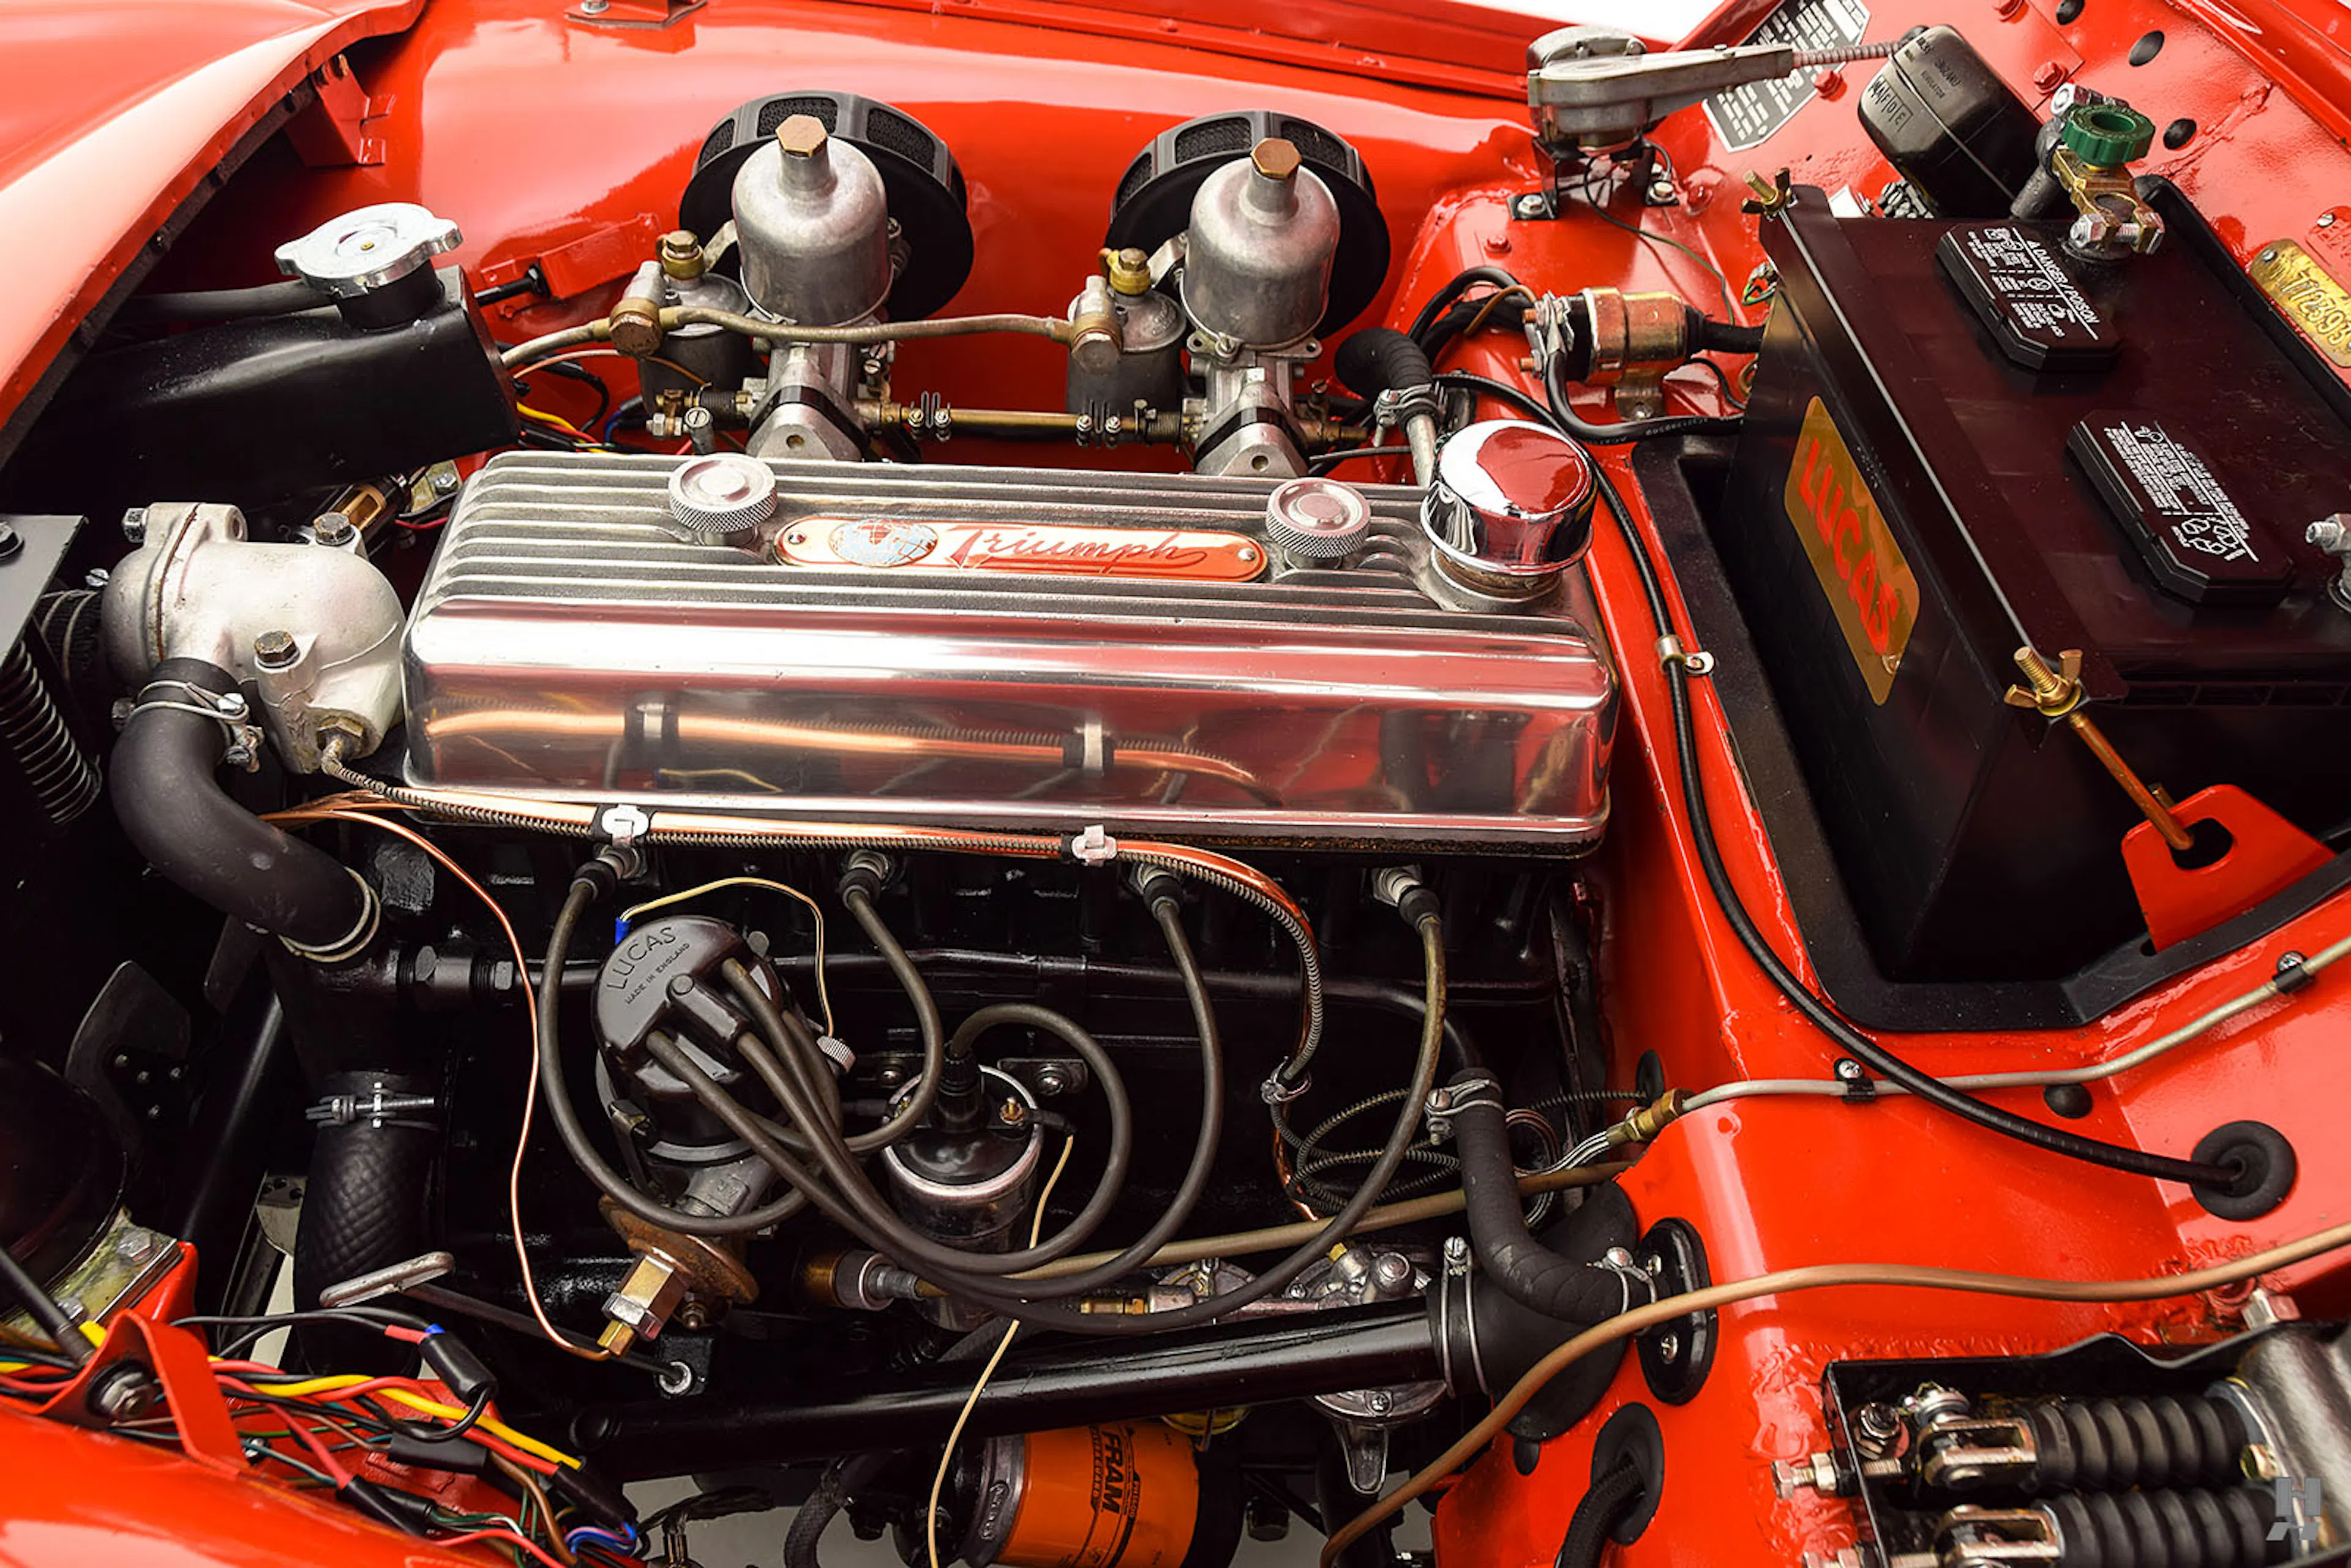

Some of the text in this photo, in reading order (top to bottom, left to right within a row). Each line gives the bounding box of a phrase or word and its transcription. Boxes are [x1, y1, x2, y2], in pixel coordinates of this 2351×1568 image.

[945, 524, 1207, 574] Triumph
[1799, 438, 1899, 655] LUCAS
[607, 927, 676, 990] LUCAS
[624, 943, 689, 1004] MADE IN ENGLAND
[1102, 1431, 1123, 1513] FRAM
